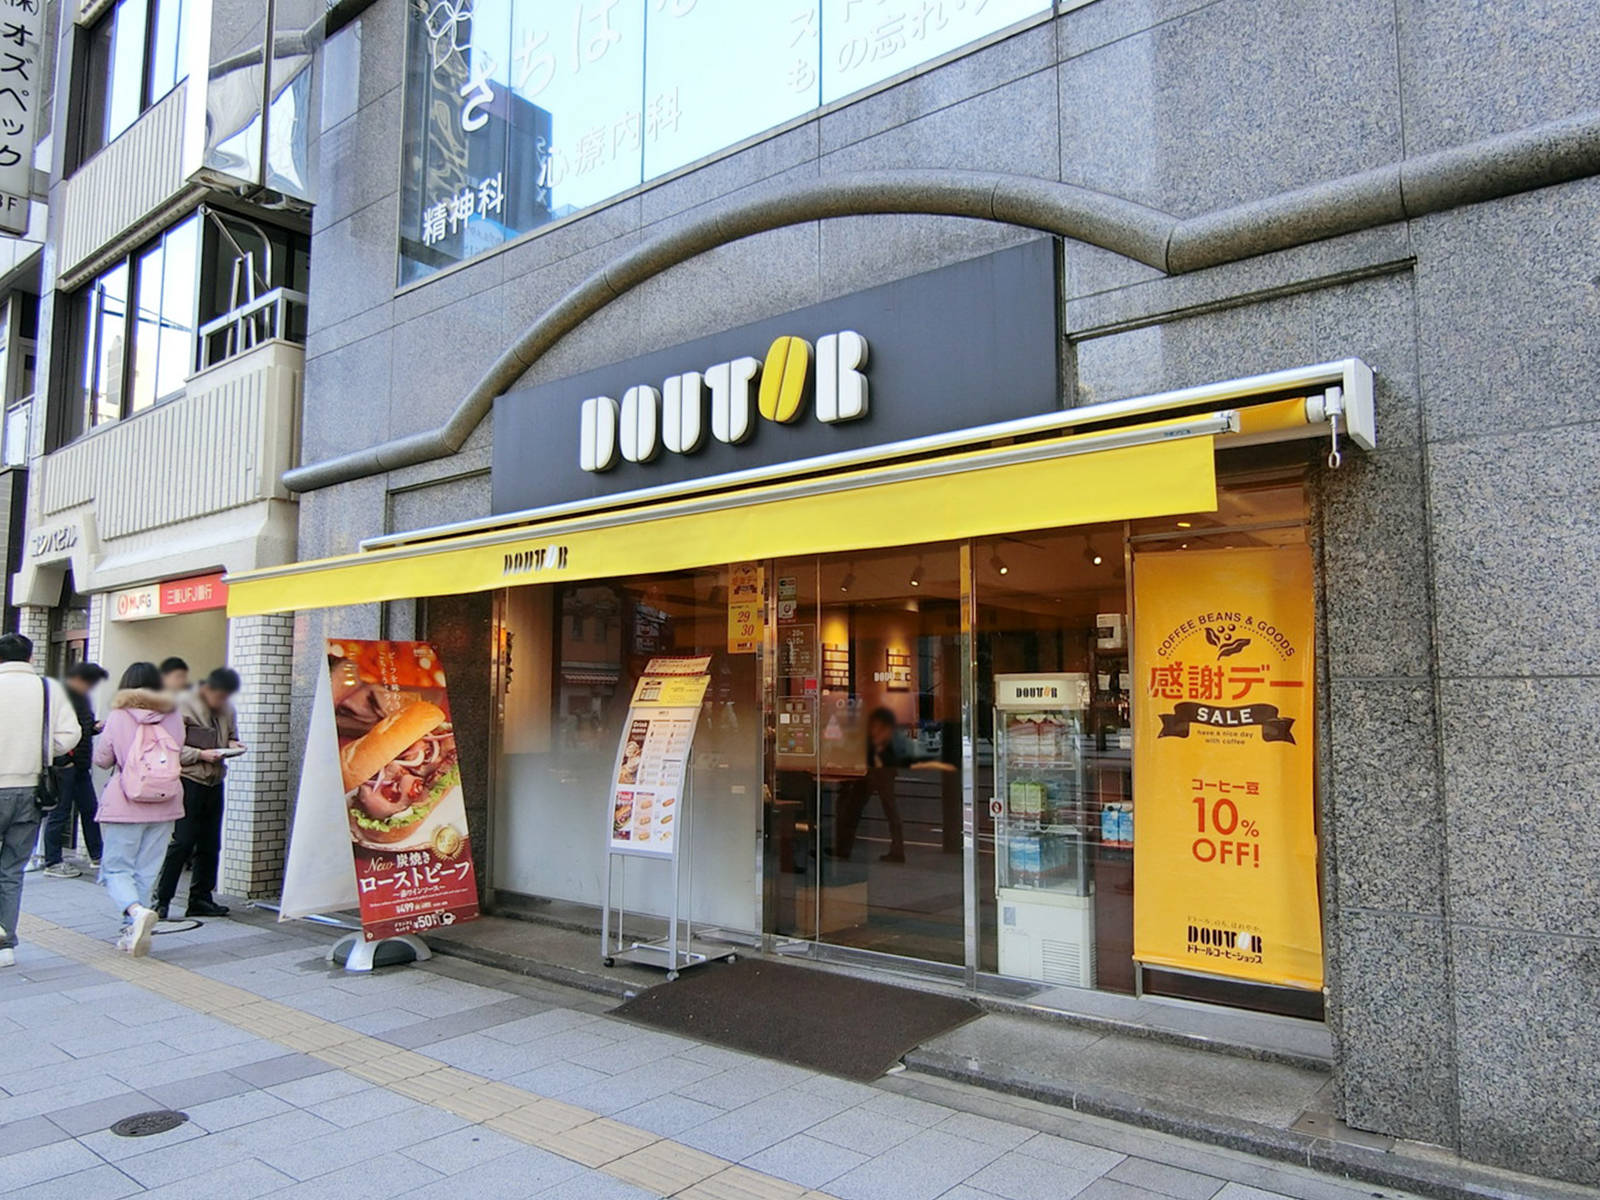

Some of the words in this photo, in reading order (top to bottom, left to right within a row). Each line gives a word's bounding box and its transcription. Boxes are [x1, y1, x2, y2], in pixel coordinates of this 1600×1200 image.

[422, 172, 504, 246] 精神科
[536, 86, 683, 188] 心療内科
[580, 330, 869, 472] DOUTOR
[503, 544, 568, 577] DOUTOR
[1157, 619, 1196, 657] COFFEE
[1197, 611, 1242, 626] BEANS
[1244, 615, 1254, 626] &
[1256, 620, 1296, 657] GOODS
[1016, 685, 1058, 699] DOUTOR
[1150, 660, 1305, 701] 感謝デー
[1196, 706, 1254, 725] SALE
[1240, 731, 1254, 739] day
[1191, 778, 1260, 795] コーヒー豆
[1192, 796, 1260, 838] 10%
[364, 856, 395, 873] New
[1192, 838, 1260, 869] OFF!
[360, 861, 470, 893] ローストビーフ
[1187, 925, 1263, 954] DOUTOR
